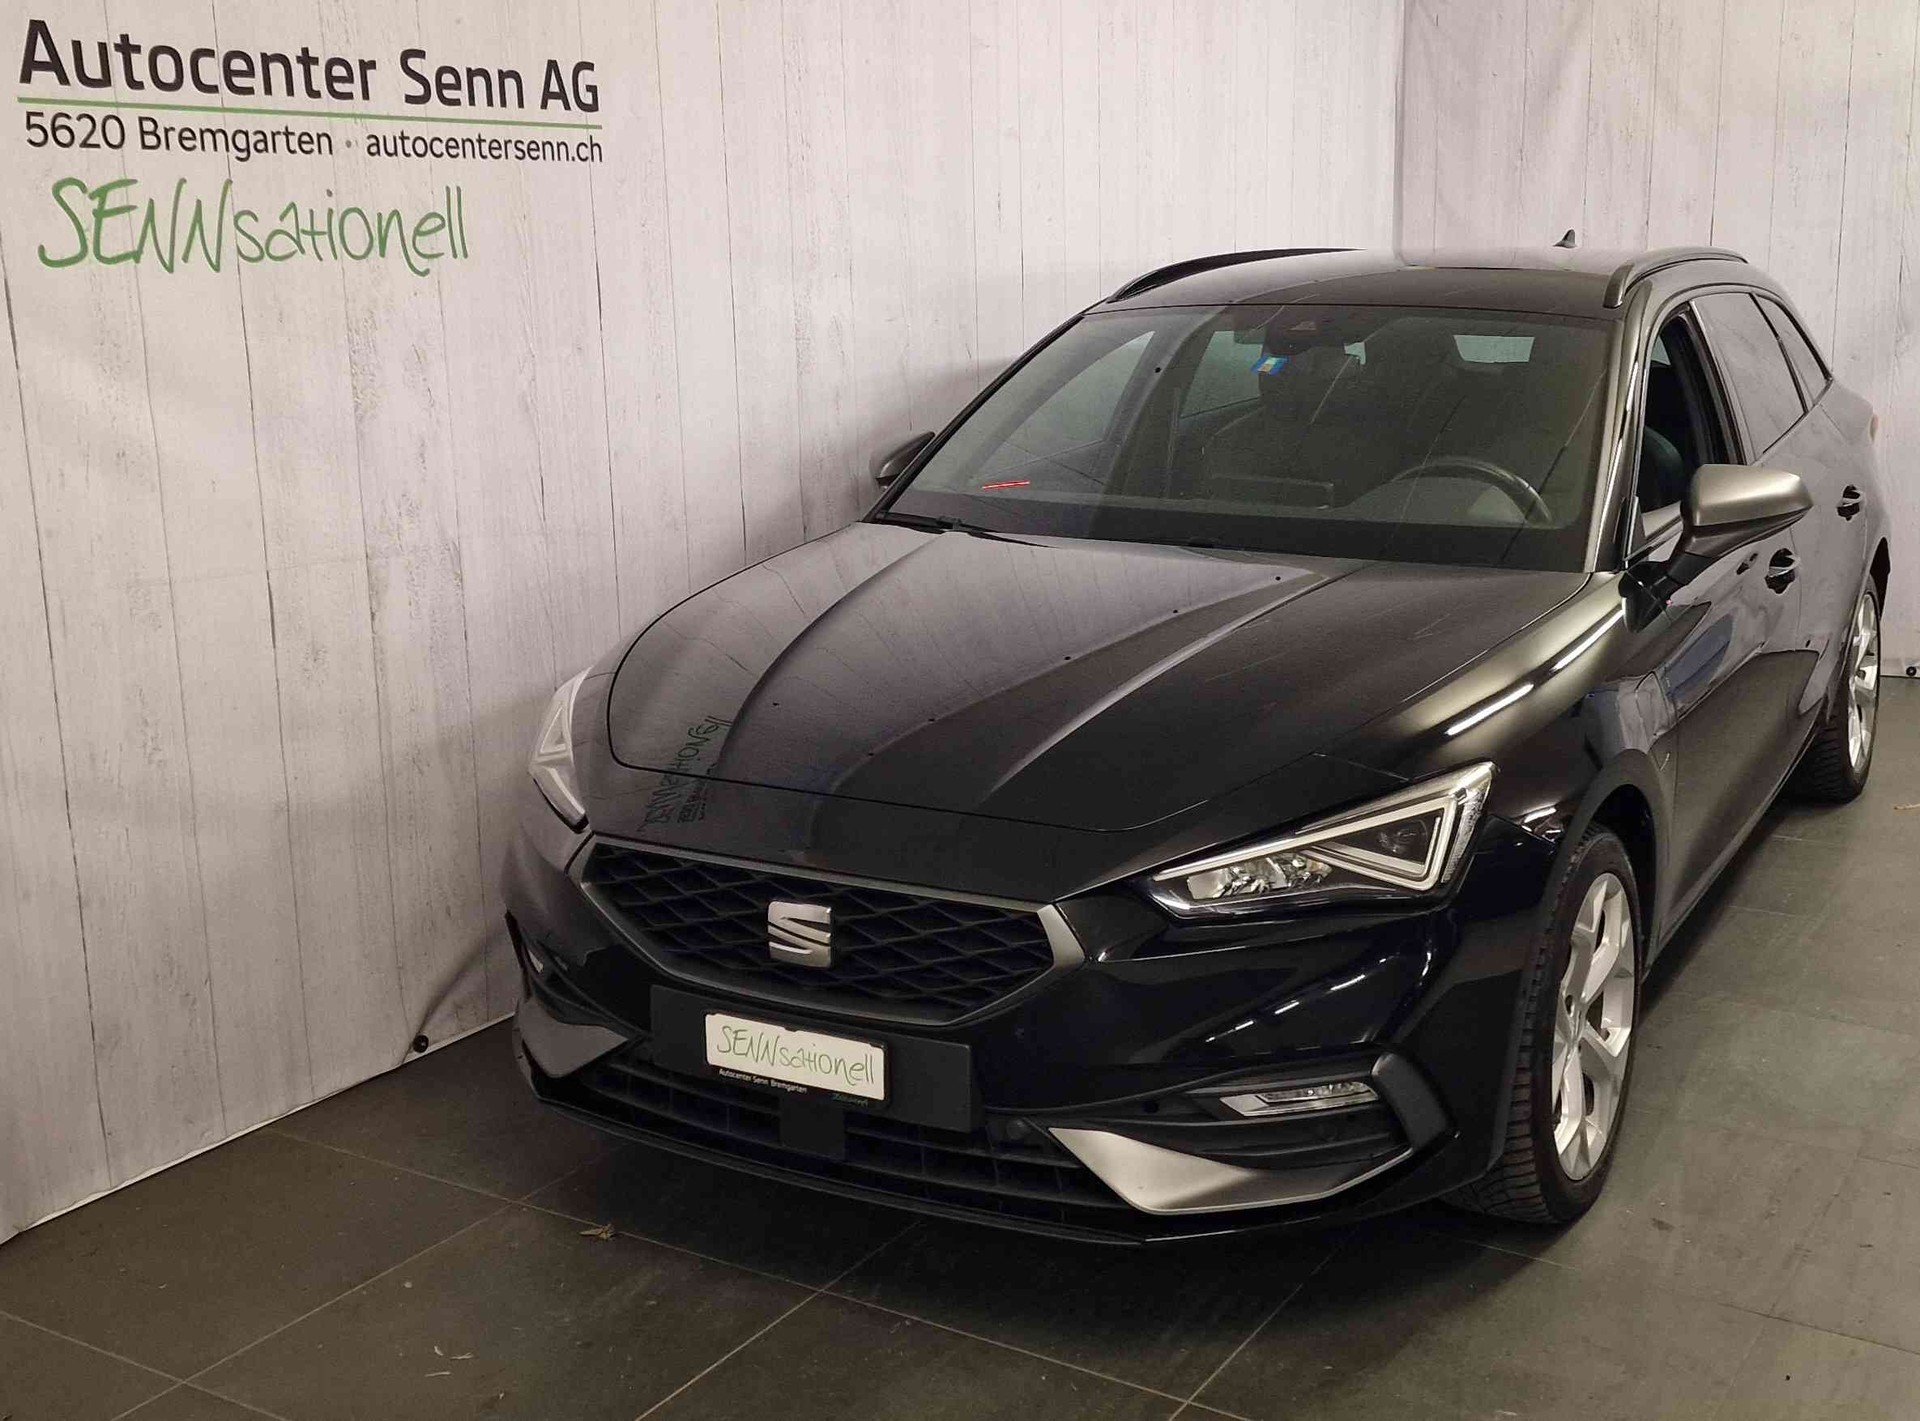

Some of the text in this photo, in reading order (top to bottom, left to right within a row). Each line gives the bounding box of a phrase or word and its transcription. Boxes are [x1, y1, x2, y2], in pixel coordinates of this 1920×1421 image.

[19, 18, 599, 112] Autocenter Senn AG
[25, 111, 602, 163] 5620 Bremgarten autocentersenn.ch
[38, 177, 469, 276] SENNsationell
[717, 1025, 875, 1086] SENNsationell
